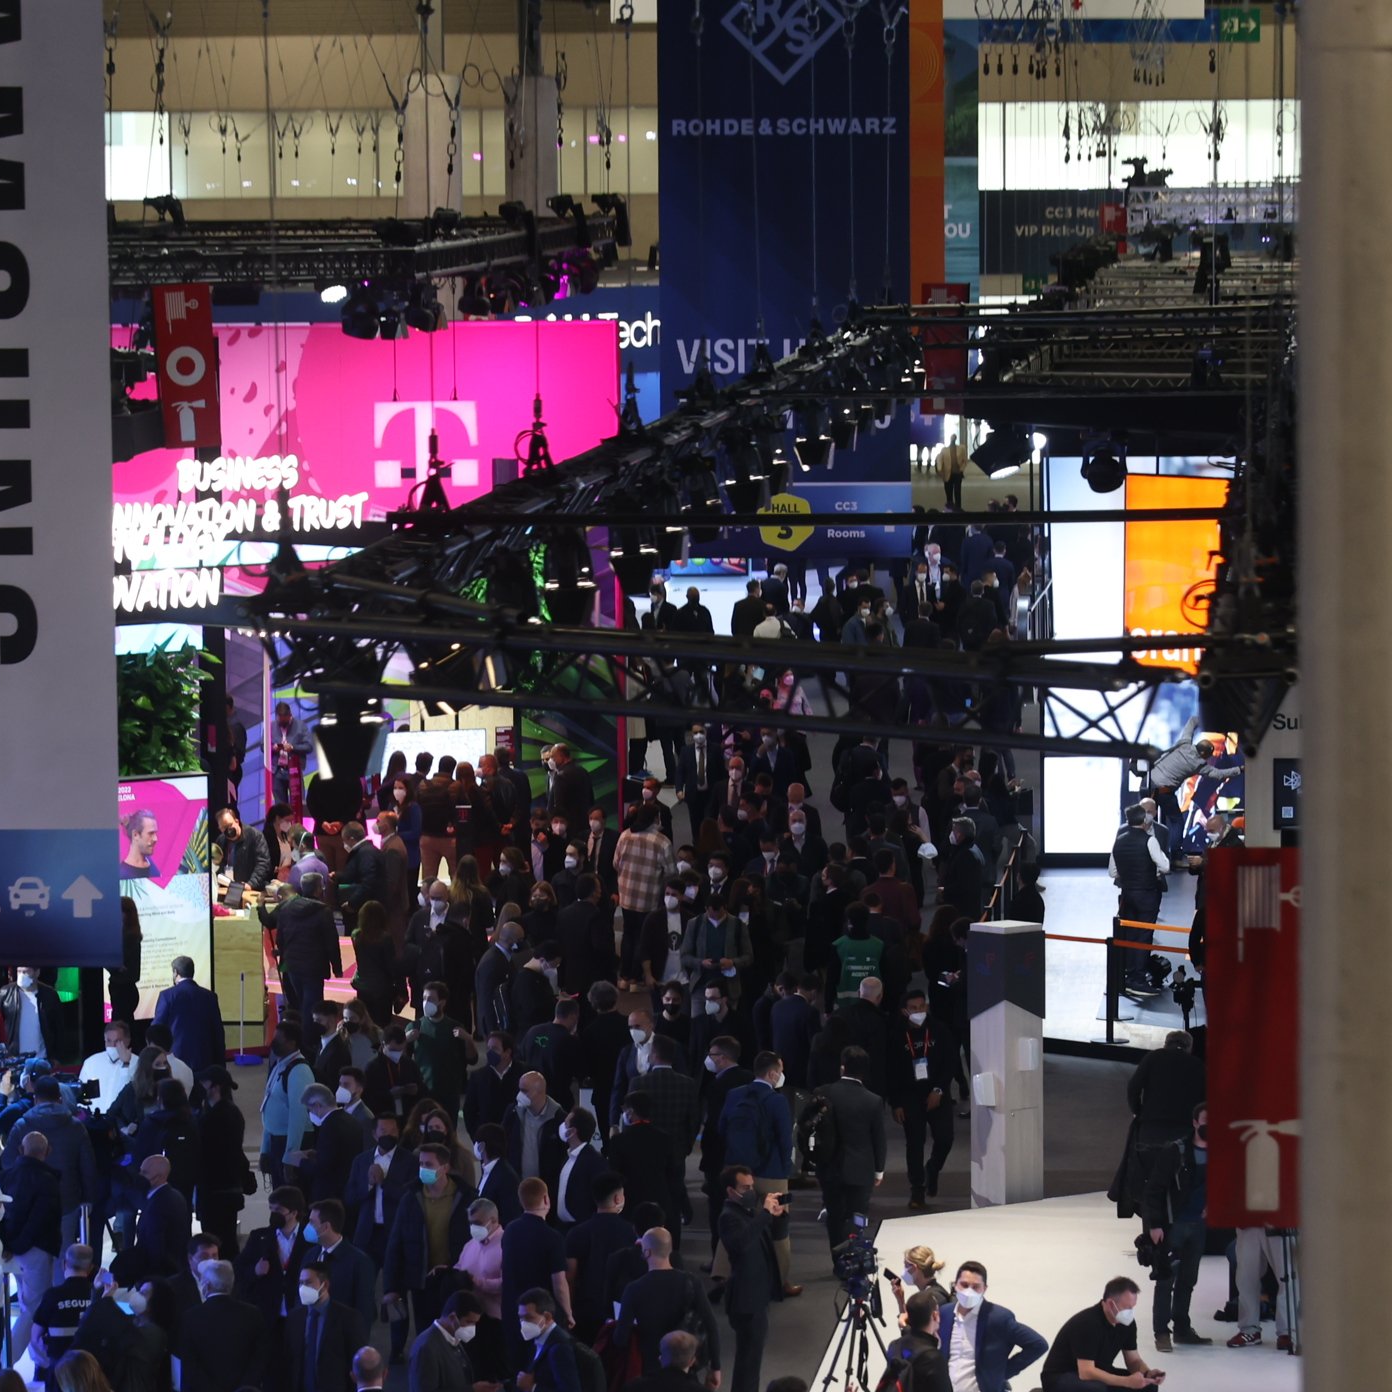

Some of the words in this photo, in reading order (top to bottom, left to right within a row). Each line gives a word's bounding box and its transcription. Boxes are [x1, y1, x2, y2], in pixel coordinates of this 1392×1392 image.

[176, 454, 300, 494] BUSINESS
[288, 492, 369, 532] TRUST
[834, 501, 858, 512] CC3
[826, 528, 867, 539] Rooms
